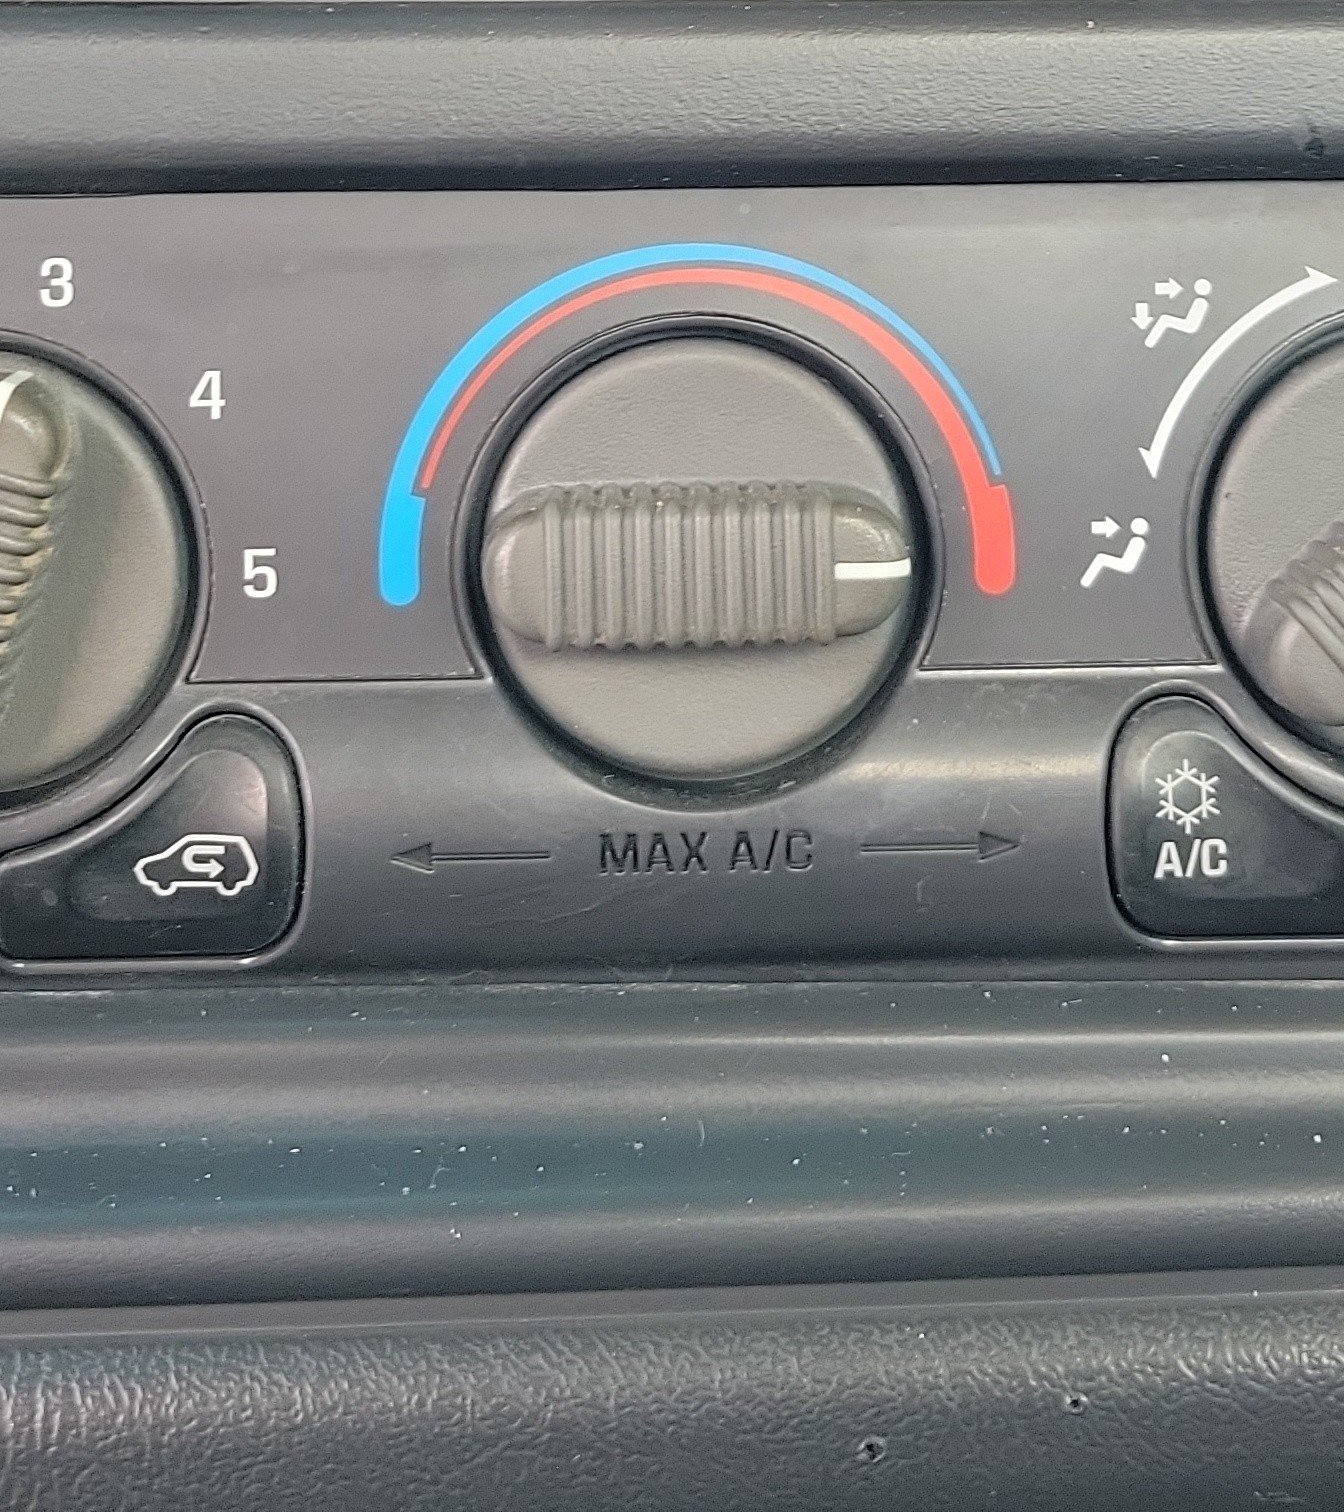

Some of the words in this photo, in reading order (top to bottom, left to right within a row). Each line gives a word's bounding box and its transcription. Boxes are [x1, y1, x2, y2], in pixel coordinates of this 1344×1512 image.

[39, 257, 74, 308] 3
[189, 370, 226, 420] 4
[243, 548, 278, 599] 5
[599, 831, 708, 875] MAX
[729, 829, 813, 874] A/C
[1154, 838, 1228, 879] A/C
